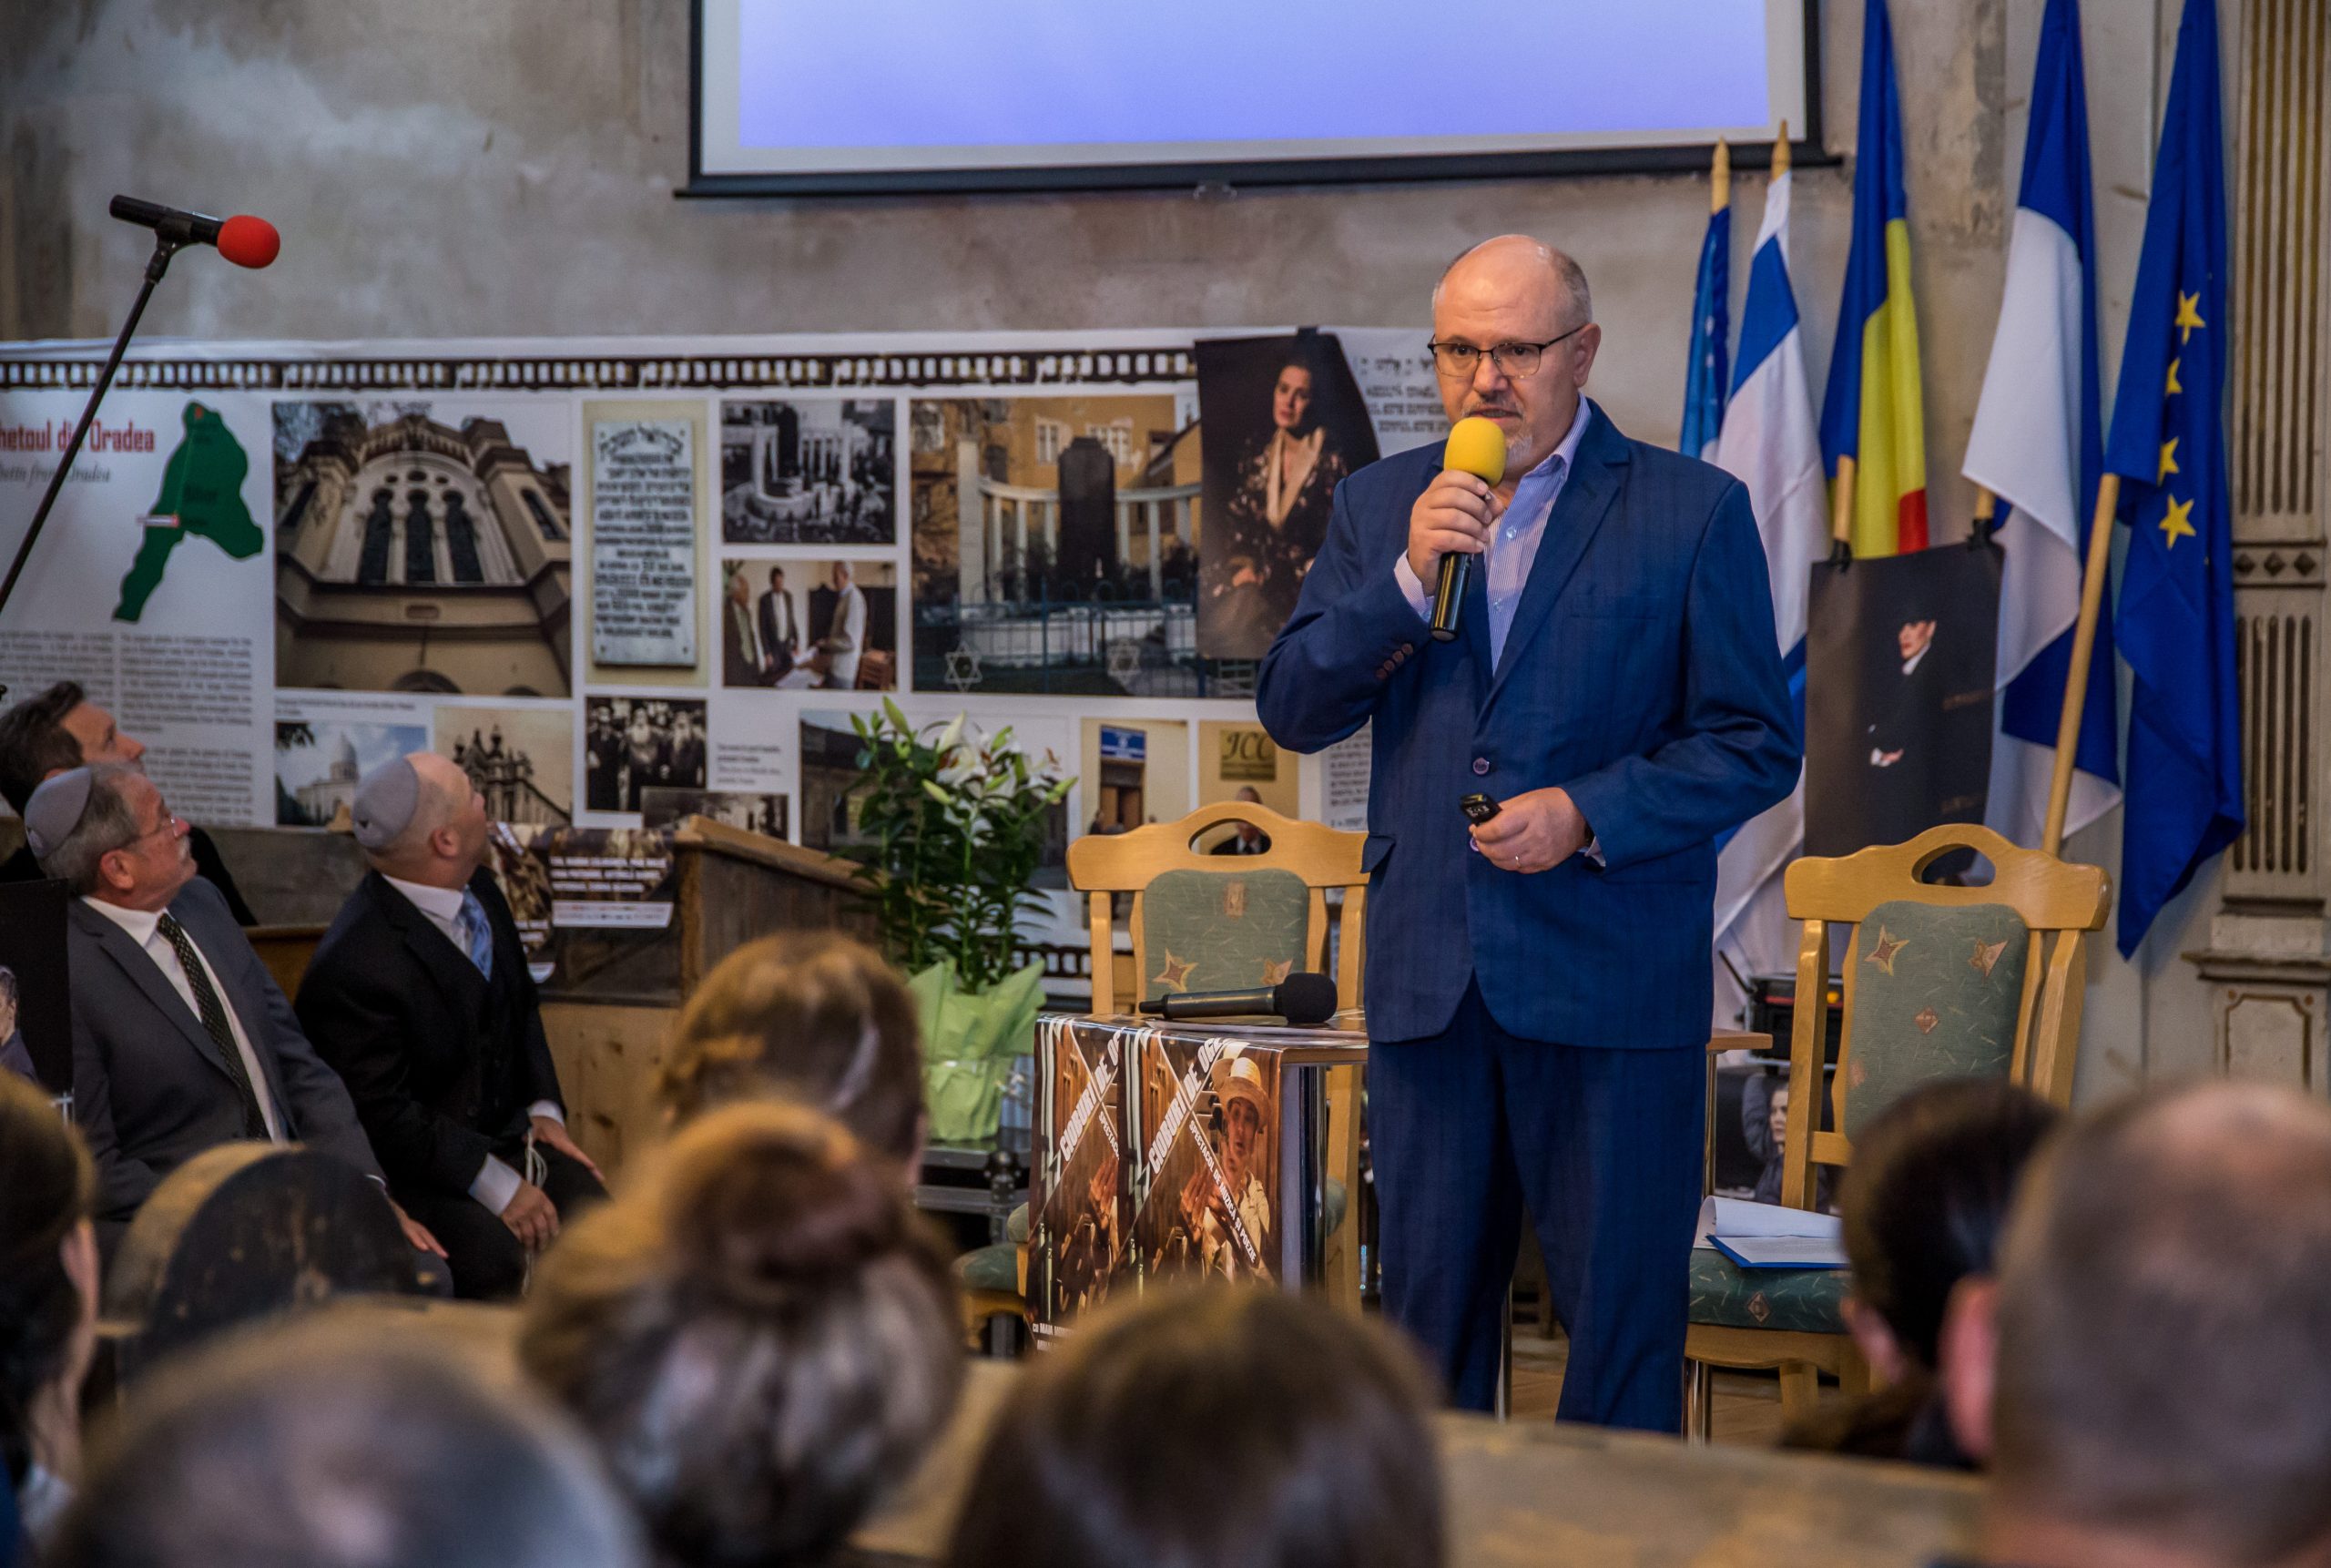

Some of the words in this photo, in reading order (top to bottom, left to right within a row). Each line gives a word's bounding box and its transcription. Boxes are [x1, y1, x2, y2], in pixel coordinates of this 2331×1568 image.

[89, 418, 155, 453] Oradea
[1222, 731, 1273, 760] JCC
[1060, 1081, 1097, 1162] CIOBURI
[1094, 1054, 1112, 1095] DE
[1148, 1090, 1187, 1175] CIOBURI
[1184, 1063, 1202, 1103] DE
[1188, 1120, 1215, 1173] SPECTACOL
[1213, 1168, 1222, 1185] DE
[1239, 1227, 1257, 1264] POEZIE
